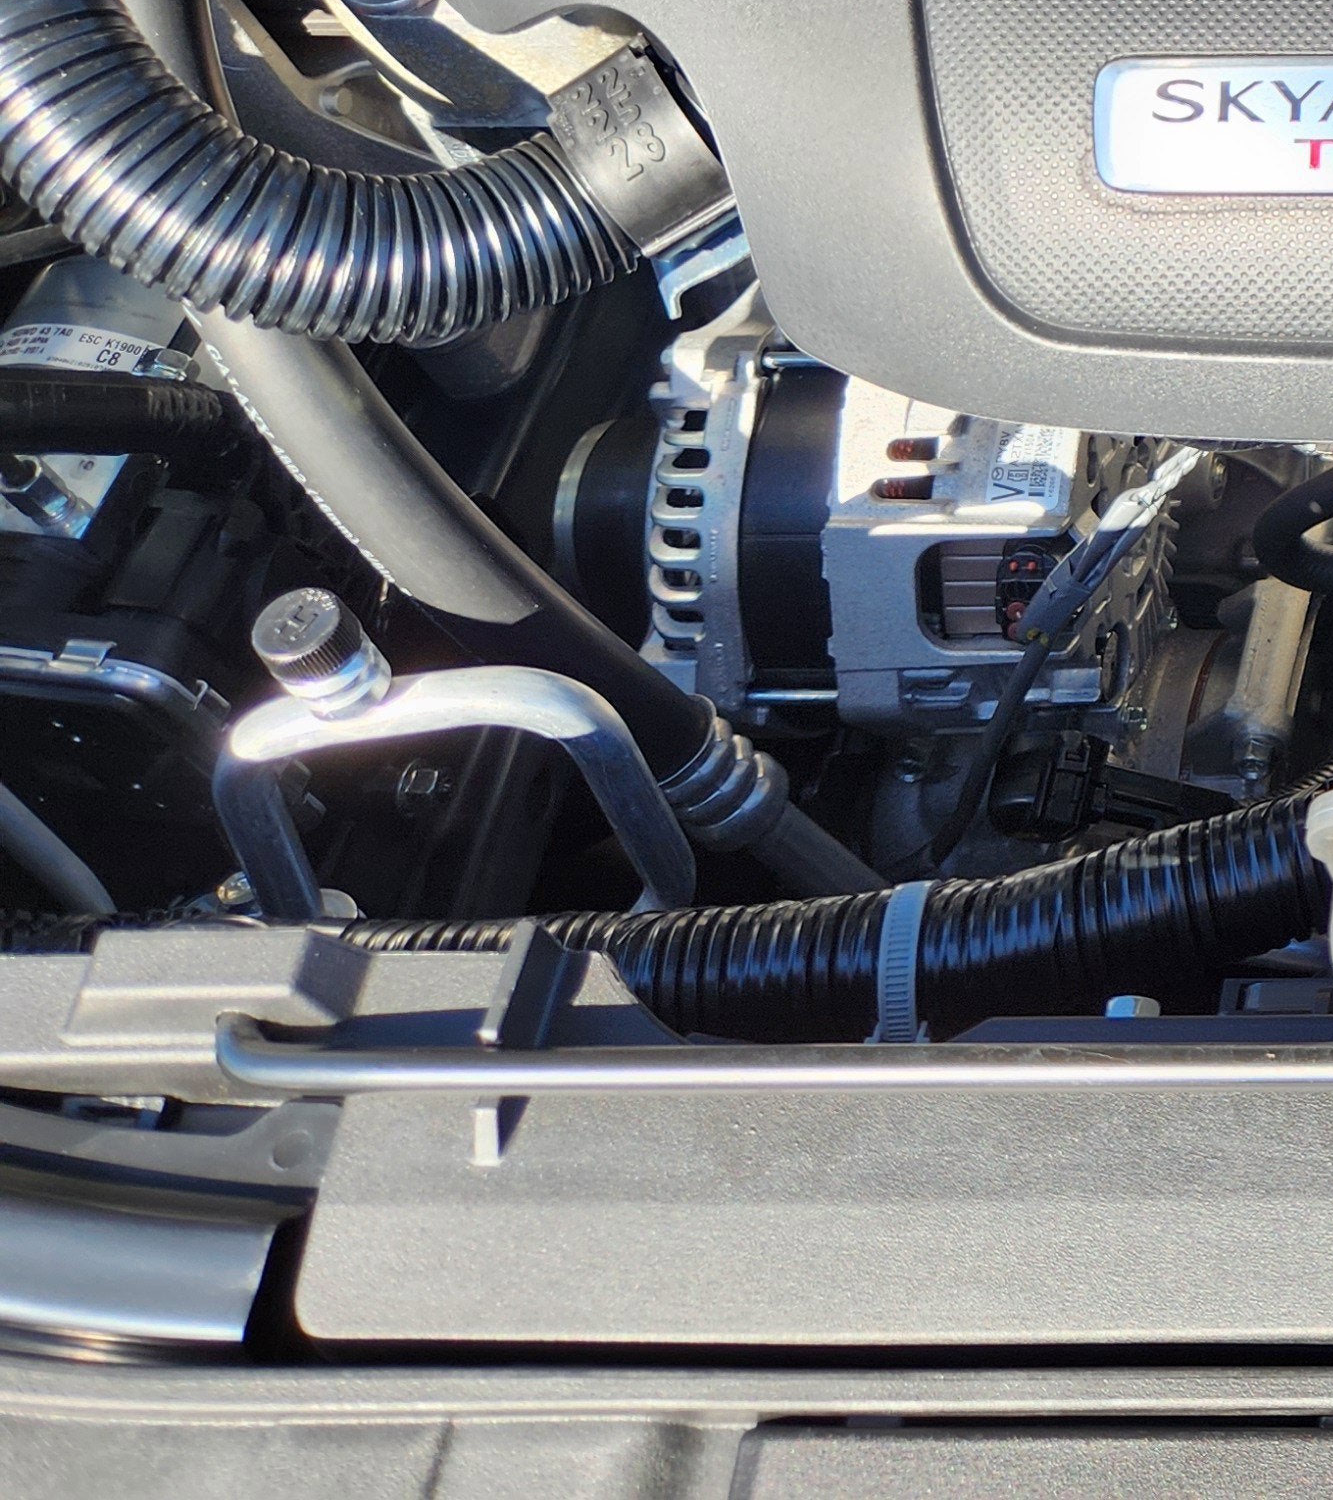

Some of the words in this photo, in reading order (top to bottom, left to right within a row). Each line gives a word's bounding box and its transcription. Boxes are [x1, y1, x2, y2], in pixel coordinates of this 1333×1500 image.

[79, 333, 103, 346] ESC
[96, 349, 122, 367] C8
[205, 343, 275, 440] GALAXY
